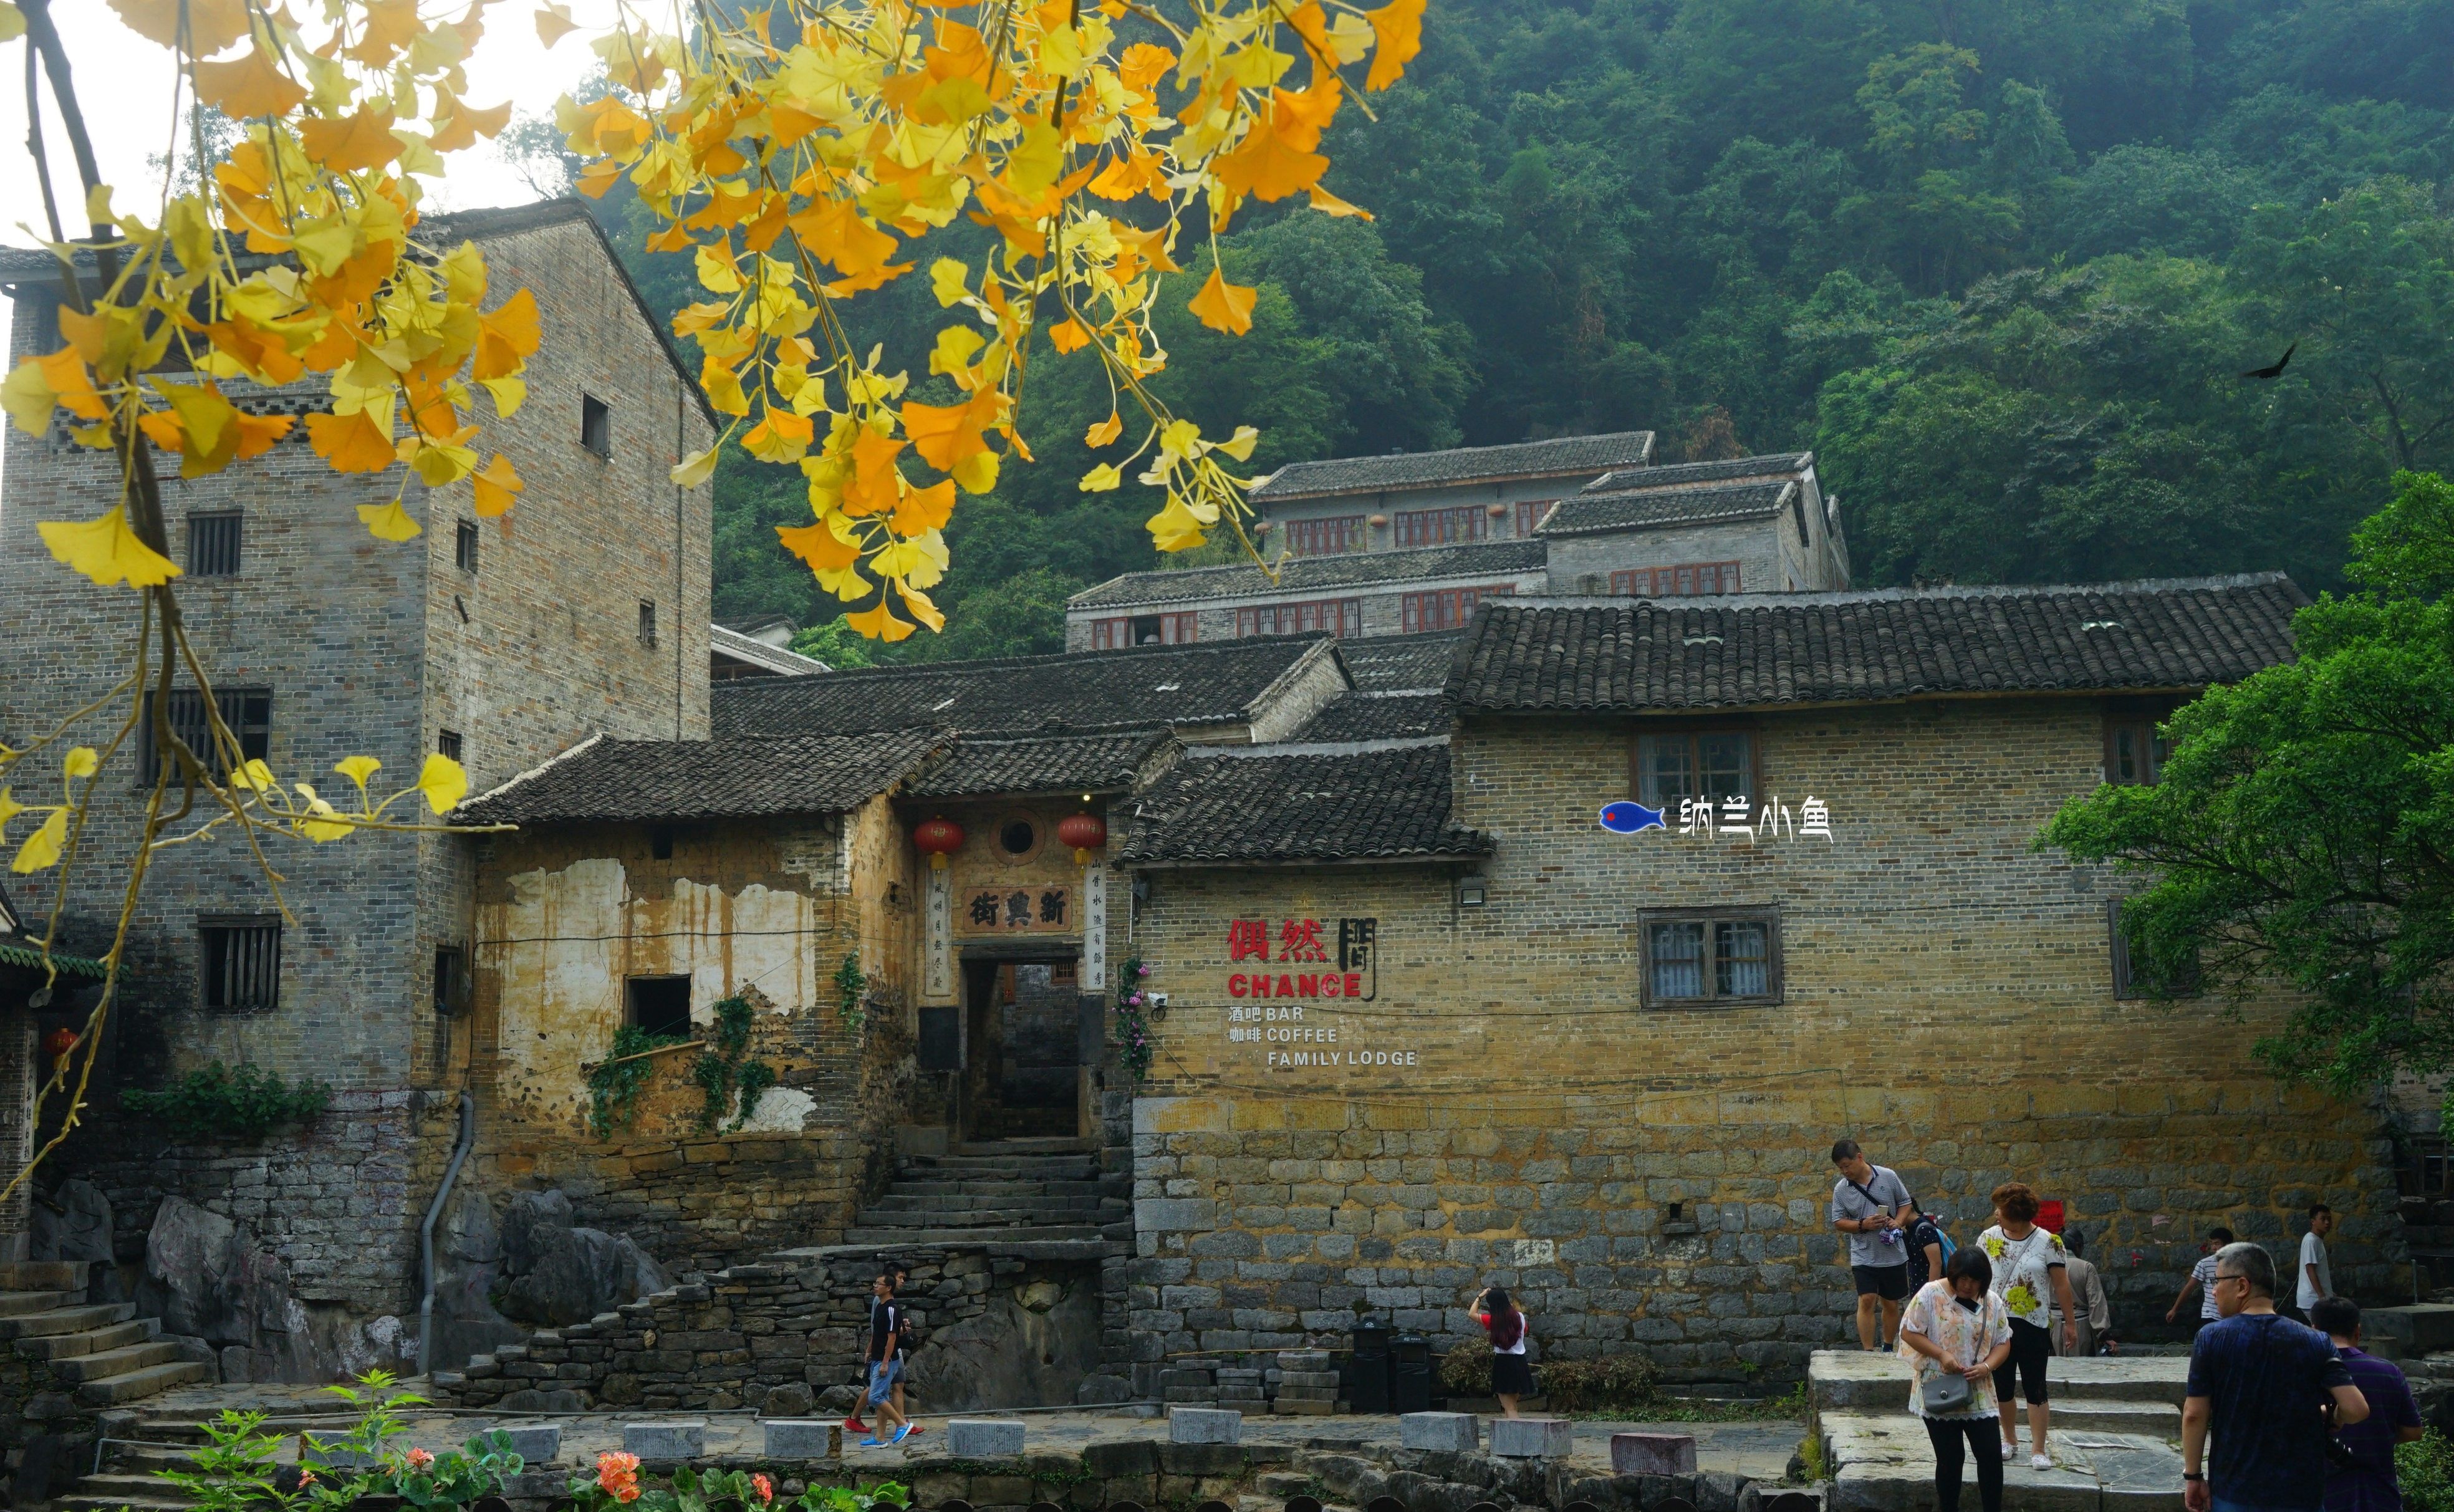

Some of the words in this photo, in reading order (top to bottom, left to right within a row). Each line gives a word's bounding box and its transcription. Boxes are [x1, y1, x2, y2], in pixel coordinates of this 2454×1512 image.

[933, 869, 944, 988] 風明月無尽藏
[1228, 973, 1361, 998] CHANCE
[1228, 1006, 1261, 1022] 酒吧
[1266, 1006, 1303, 1021] BAR
[1229, 1028, 1261, 1043] 咖啡
[1267, 1028, 1337, 1043] COFFEE
[1268, 1052, 1340, 1066] FAMILY
[1349, 1051, 1417, 1066] LODGE
